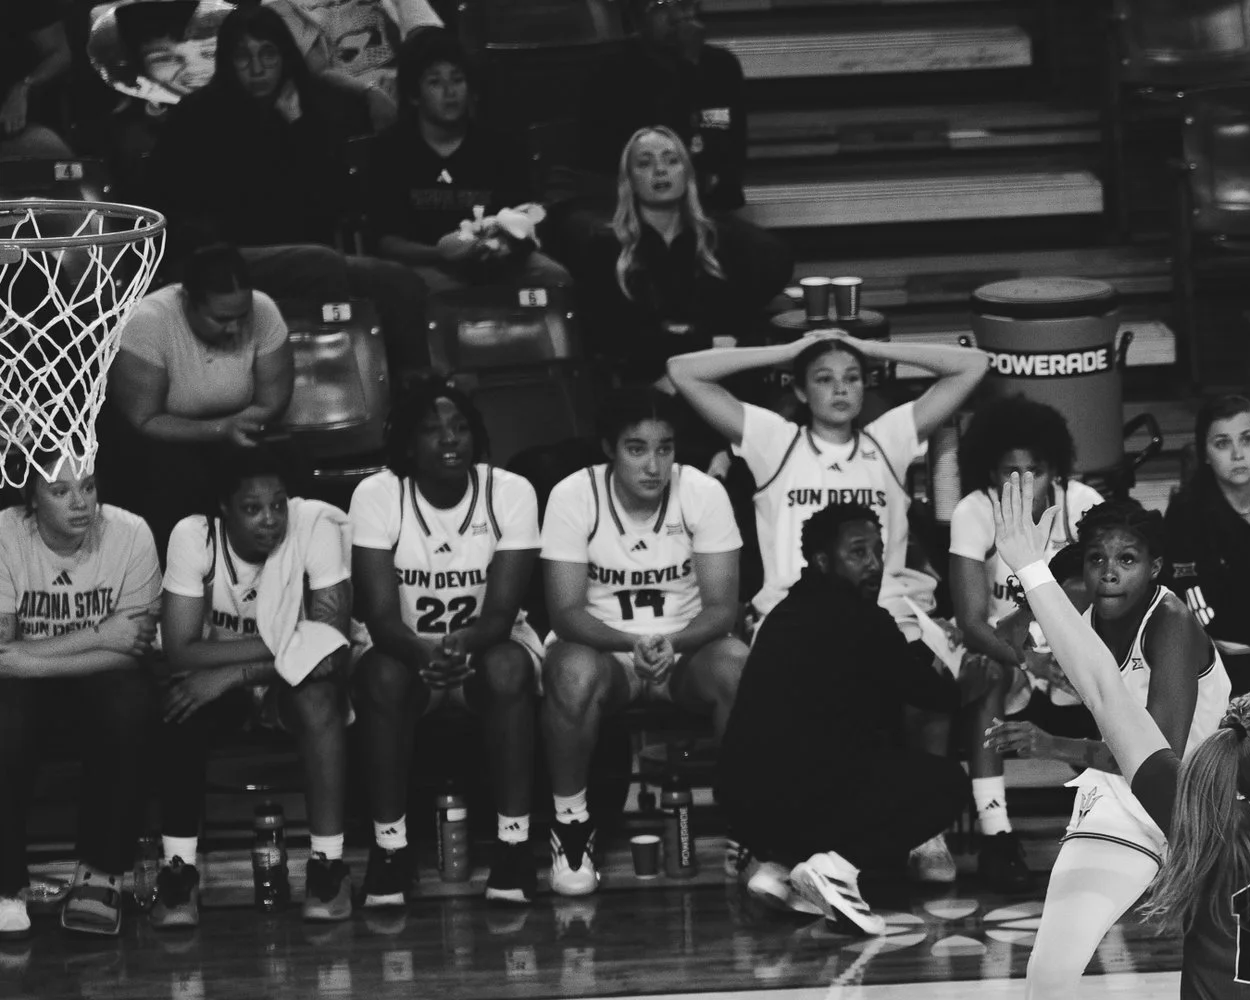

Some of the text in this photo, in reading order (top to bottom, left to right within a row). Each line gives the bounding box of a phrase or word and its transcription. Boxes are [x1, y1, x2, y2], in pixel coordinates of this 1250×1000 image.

[986, 351, 1108, 375] POWERADE
[787, 489, 886, 507] SUN DEVILS
[434, 569, 487, 589] DEVIL
[587, 559, 691, 585] SUN DEVILS
[75, 587, 113, 618] STATE
[416, 595, 478, 633] 22
[212, 609, 239, 632] UN
